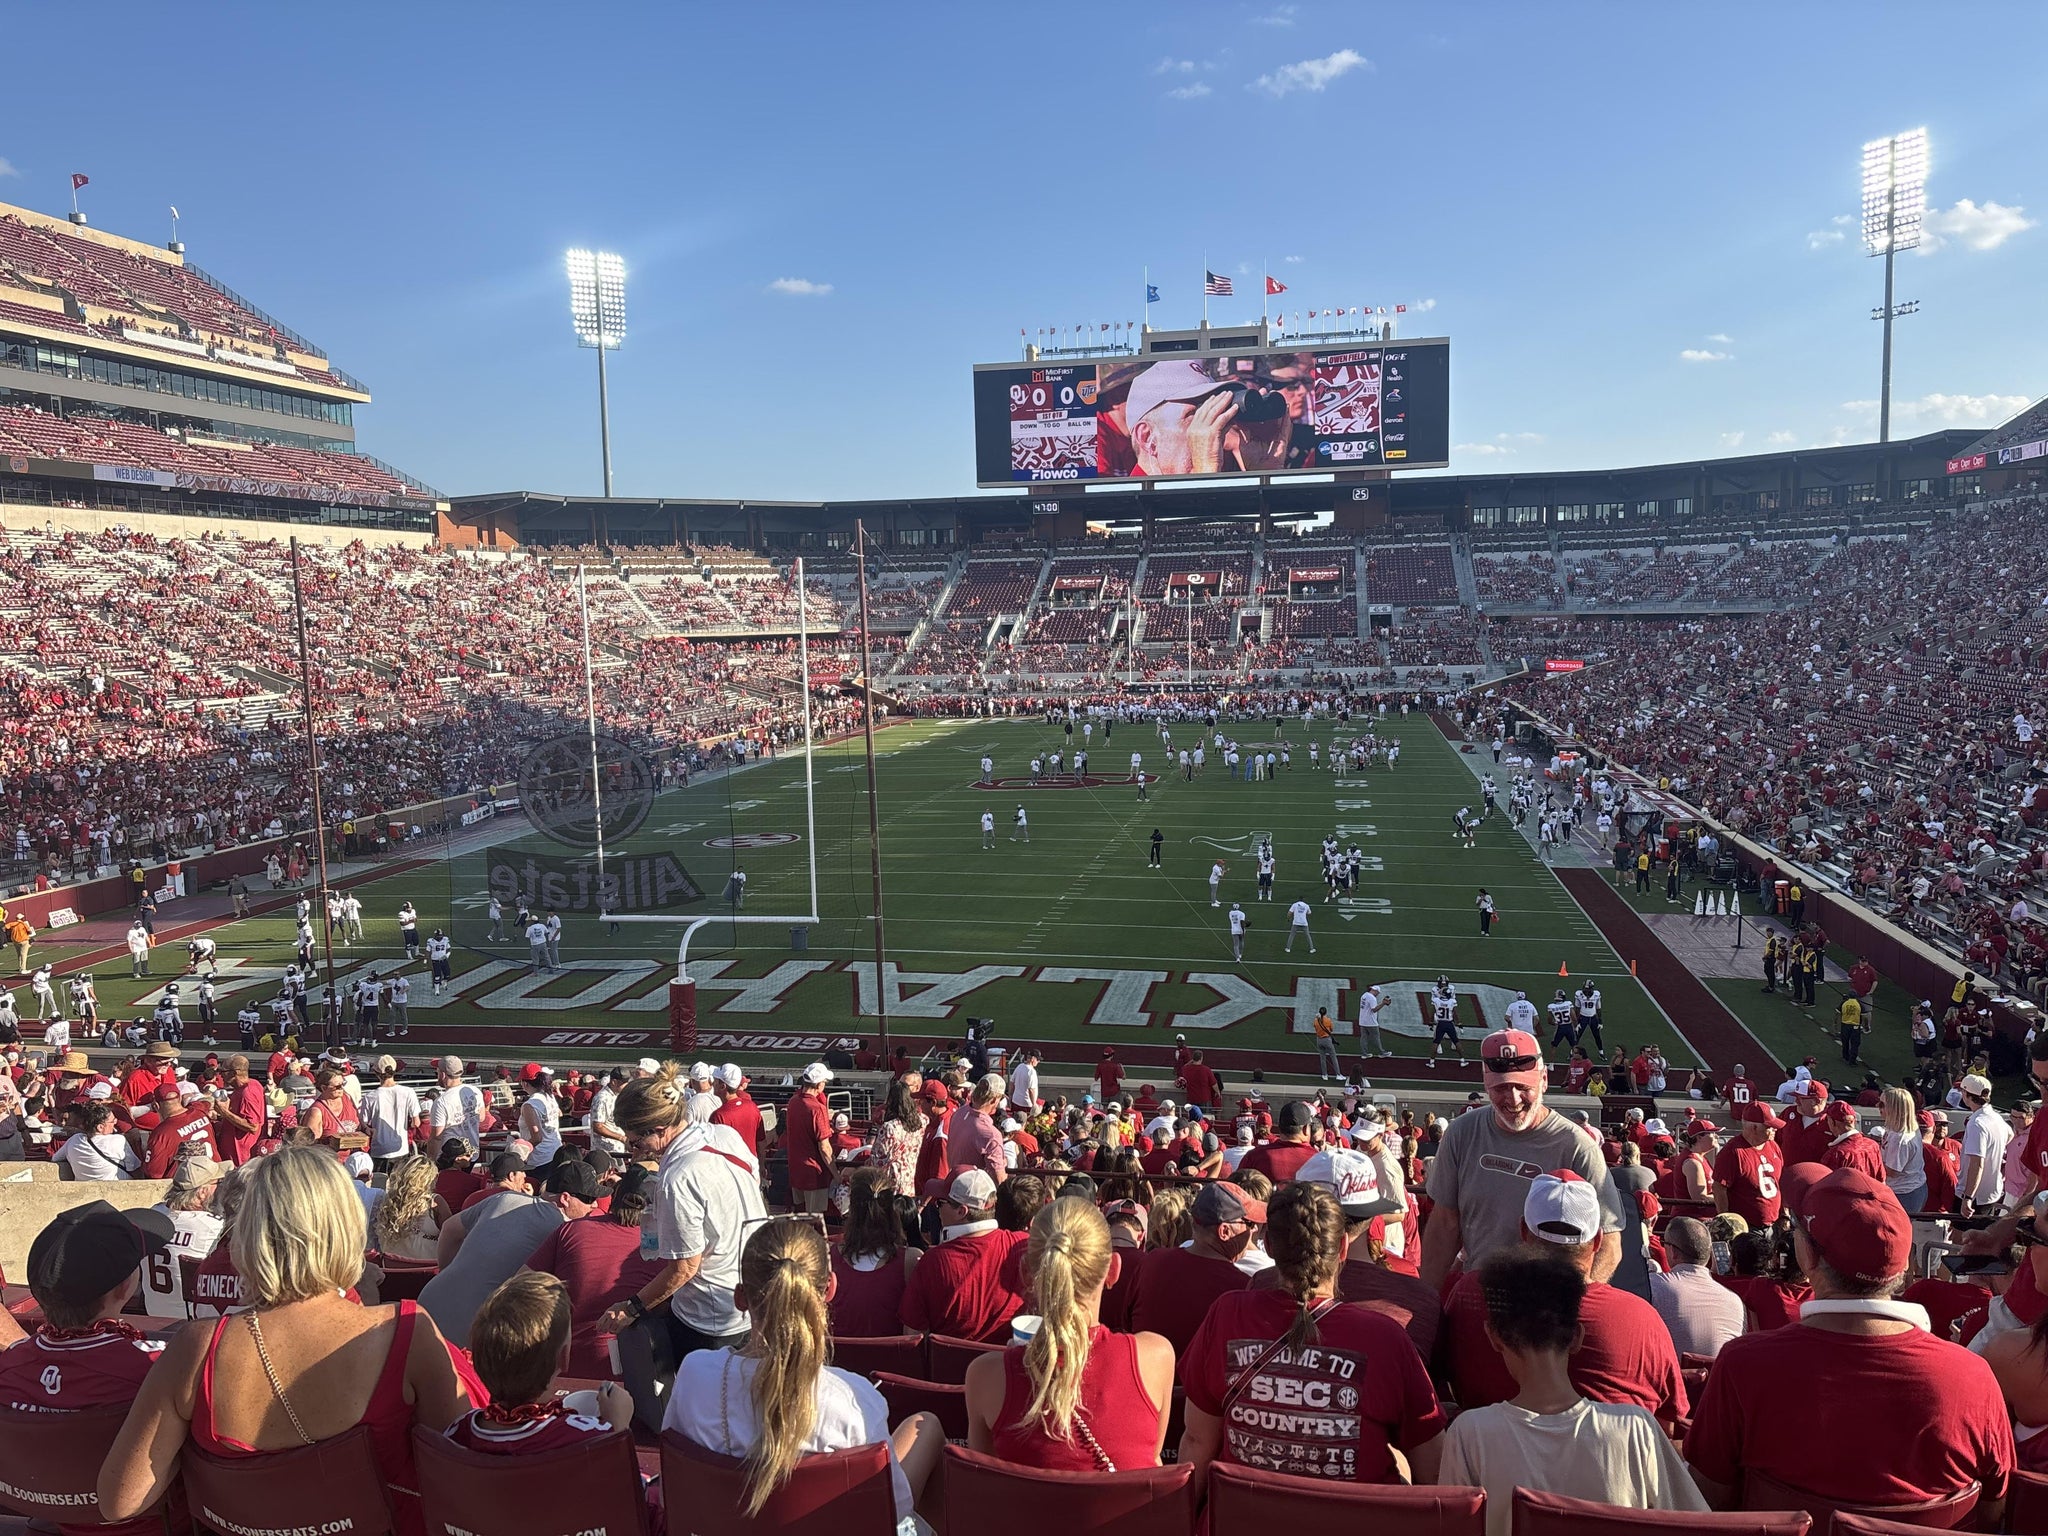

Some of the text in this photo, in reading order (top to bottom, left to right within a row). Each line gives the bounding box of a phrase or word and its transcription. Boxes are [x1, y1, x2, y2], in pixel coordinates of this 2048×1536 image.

[1032, 388, 1046, 406] 0
[1061, 386, 1074, 405] 0
[115, 467, 155, 482] WEB DESIGN
[1354, 489, 1367, 499] 25
[401, 500, 416, 509] Google
[1187, 574, 1205, 584] OU
[366, 991, 374, 1002] 4
[1437, 1007, 1449, 1019] 31
[1554, 1011, 1570, 1024] 35
[240, 1020, 252, 1032] 32
[541, 1031, 829, 1050] SOONE CLUB
[1732, 1087, 1750, 1104] 10
[177, 1116, 210, 1138] MAYFIELD
[144, 1150, 152, 1163] 6
[1757, 1162, 1778, 1199] 6
[147, 1248, 174, 1294] 6
[1329, 1354, 1356, 1379] TO
[40, 1365, 62, 1395] OU
[1251, 1375, 1332, 1408] SEC
[1340, 1388, 1358, 1408] SEC
[1230, 1405, 1355, 1437] COUNTRY
